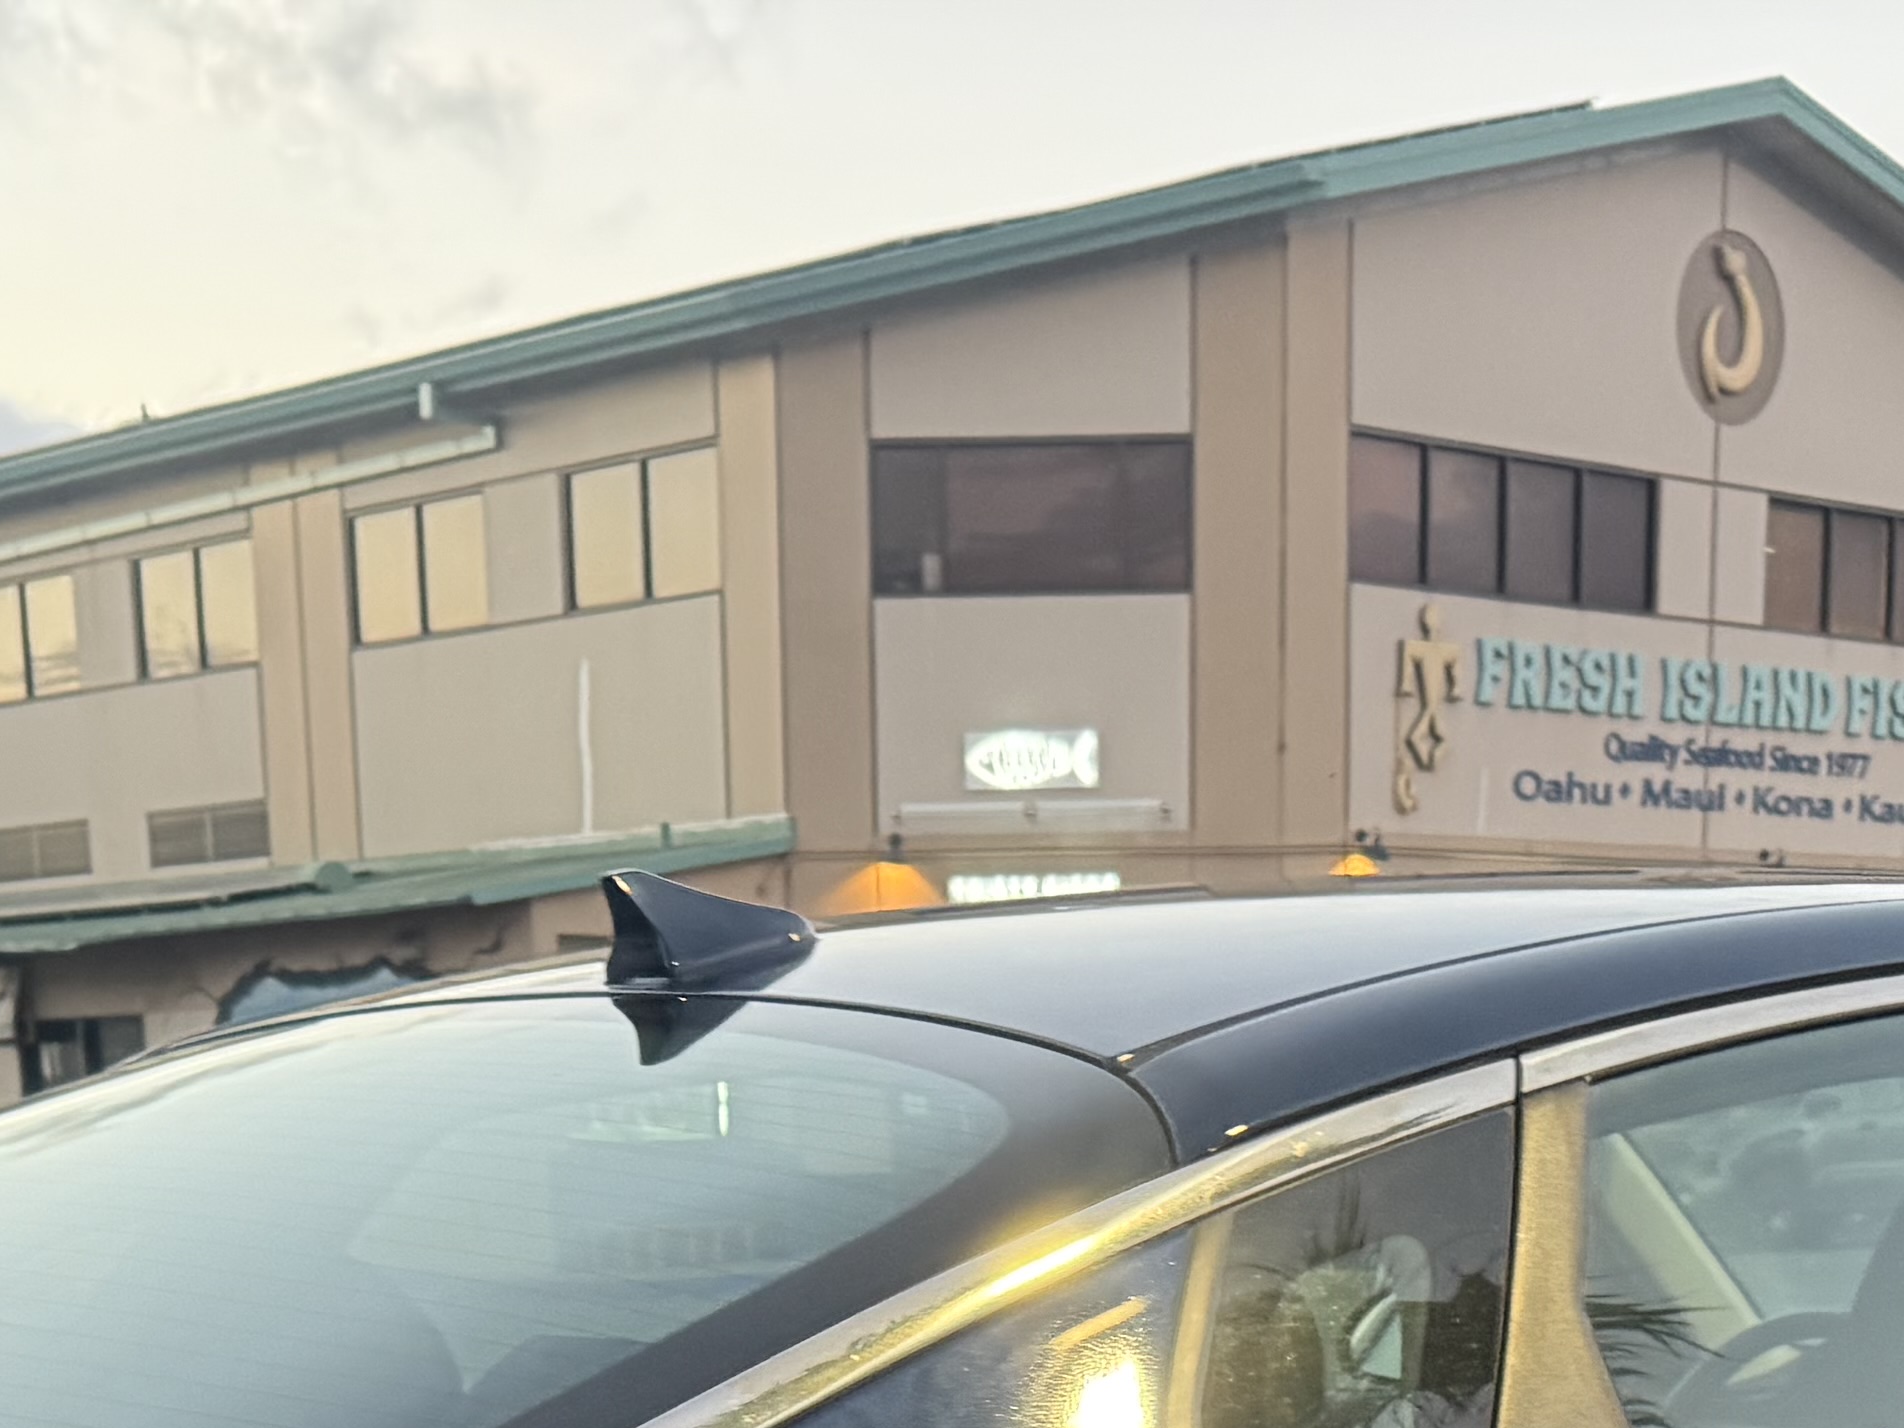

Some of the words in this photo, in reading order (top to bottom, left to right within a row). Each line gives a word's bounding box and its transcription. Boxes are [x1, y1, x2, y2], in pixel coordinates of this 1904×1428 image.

[1475, 636, 1645, 720] FRESH
[1659, 655, 1839, 735] ISLAND
[1604, 732, 1680, 770] Quality
[1683, 737, 1765, 770] Seafood
[1768, 746, 1821, 776] Since
[1826, 751, 1872, 779] 1977
[1512, 769, 1613, 806] Oahu
[1640, 777, 1726, 812] Maui
[1752, 785, 1835, 820] Kona
